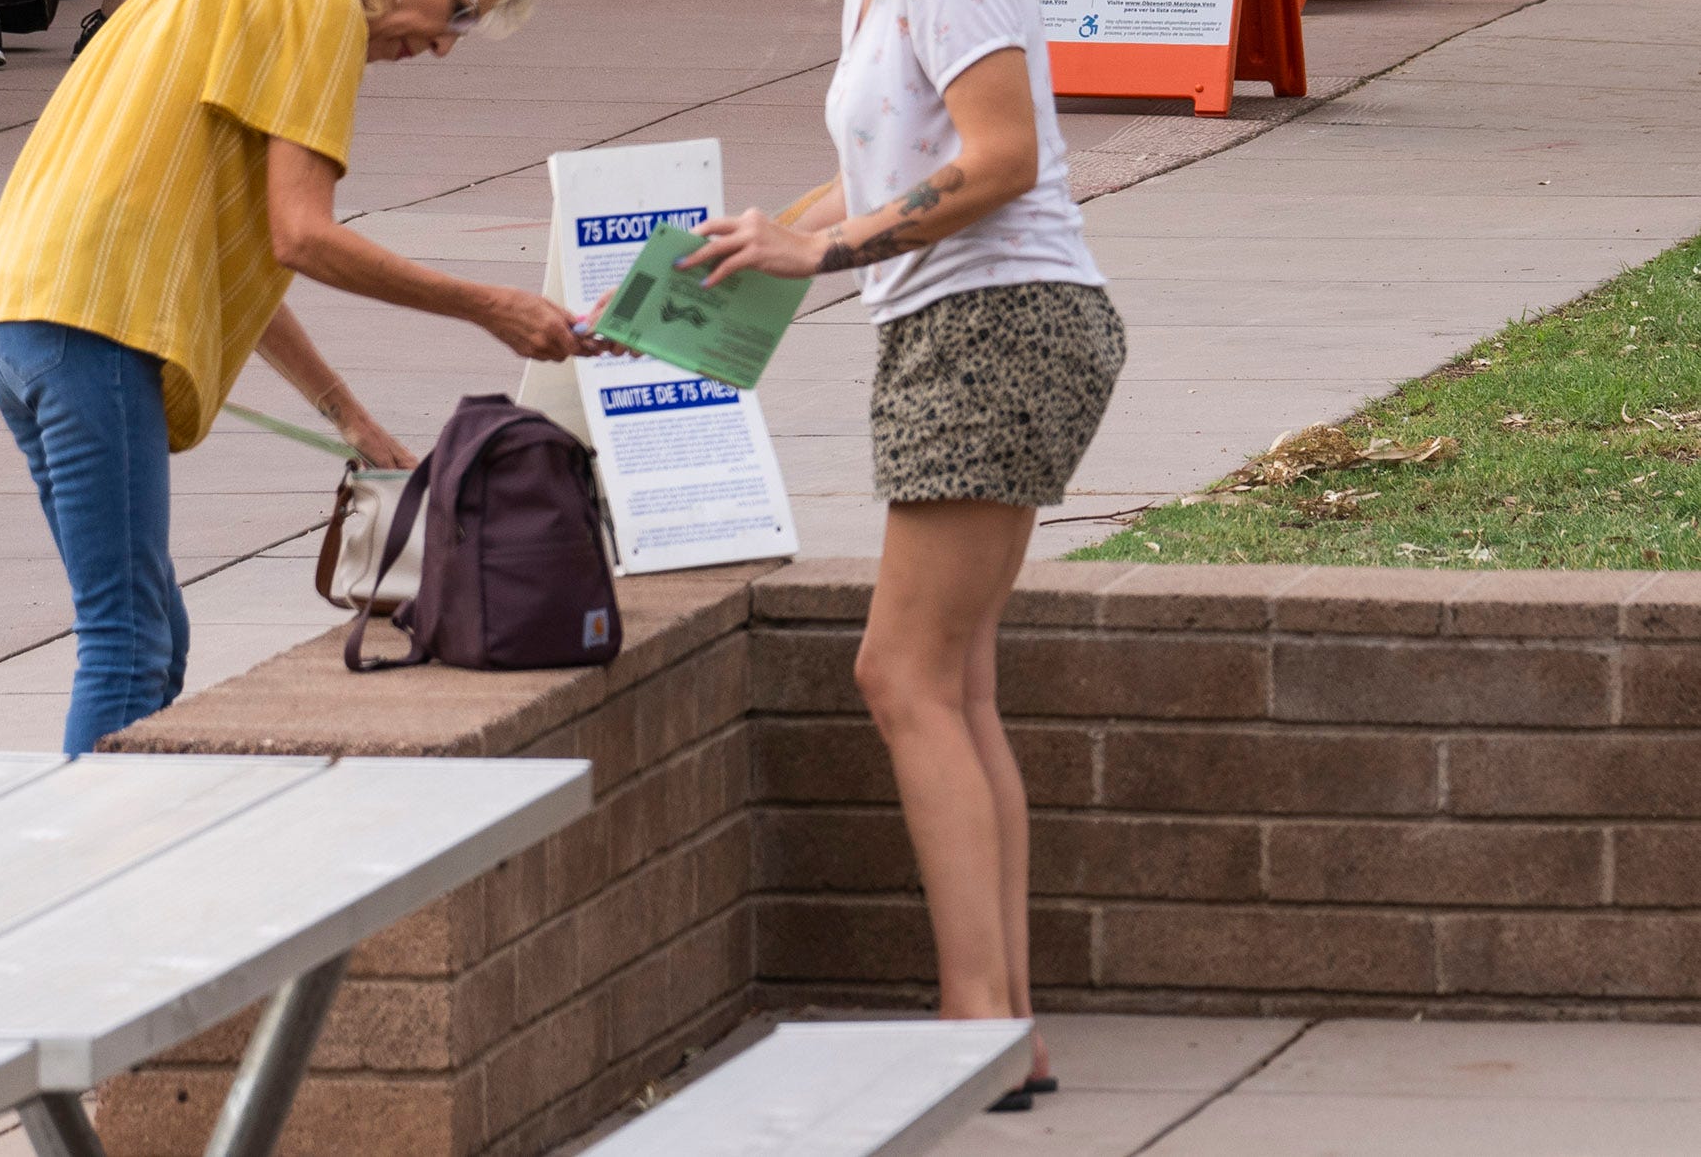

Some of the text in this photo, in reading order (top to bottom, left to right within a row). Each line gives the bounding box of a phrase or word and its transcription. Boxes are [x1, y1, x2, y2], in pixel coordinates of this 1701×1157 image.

[582, 220, 603, 243] 75
[606, 215, 654, 241] FOOT
[603, 387, 654, 410] LIMITE
[654, 384, 678, 405] DE
[678, 382, 699, 403] 75
